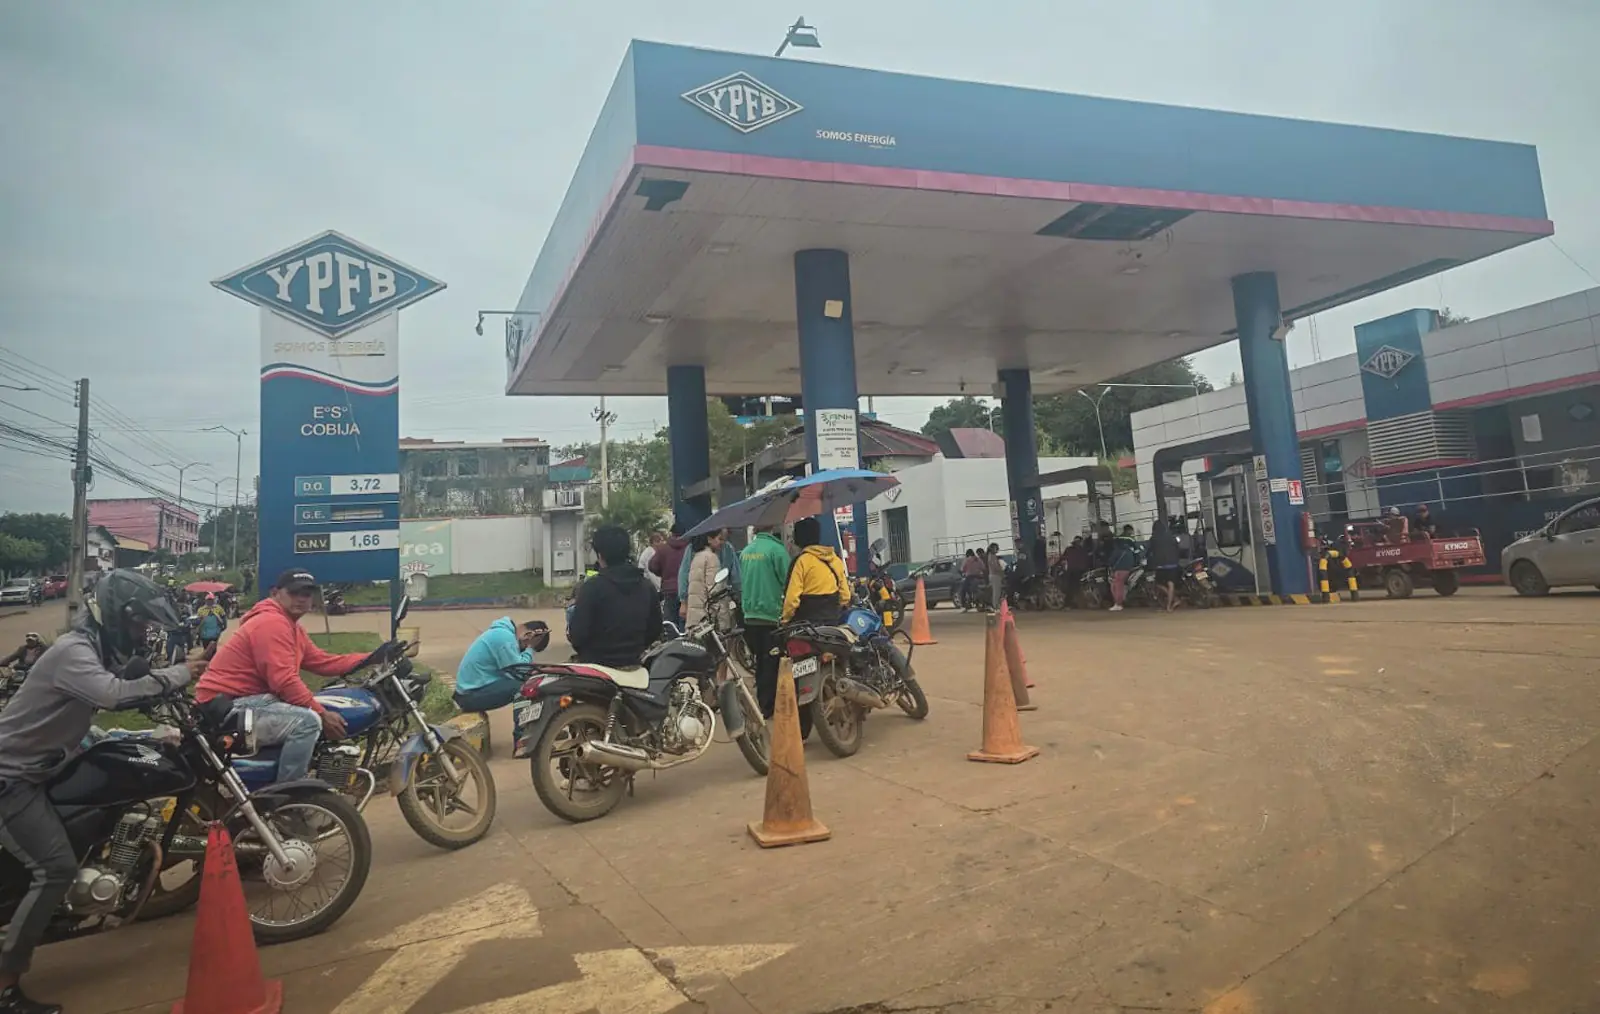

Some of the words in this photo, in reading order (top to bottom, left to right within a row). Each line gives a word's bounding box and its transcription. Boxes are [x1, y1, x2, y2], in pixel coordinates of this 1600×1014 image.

[708, 84, 777, 122] YPFB
[816, 129, 853, 142] SOMOS
[854, 130, 896, 146] ENERGÍA
[266, 251, 396, 316] YPFB
[273, 341, 325, 353] SOMOS
[328, 339, 386, 352] EERGÍA
[1370, 351, 1404, 372] YPFB
[300, 423, 360, 436] COBIJA
[303, 482, 324, 491] D.O.
[350, 478, 380, 491] 3,72
[302, 511, 325, 519] G.E.
[349, 534, 380, 547] 1,66
[128, 756, 159, 766] HONDA
